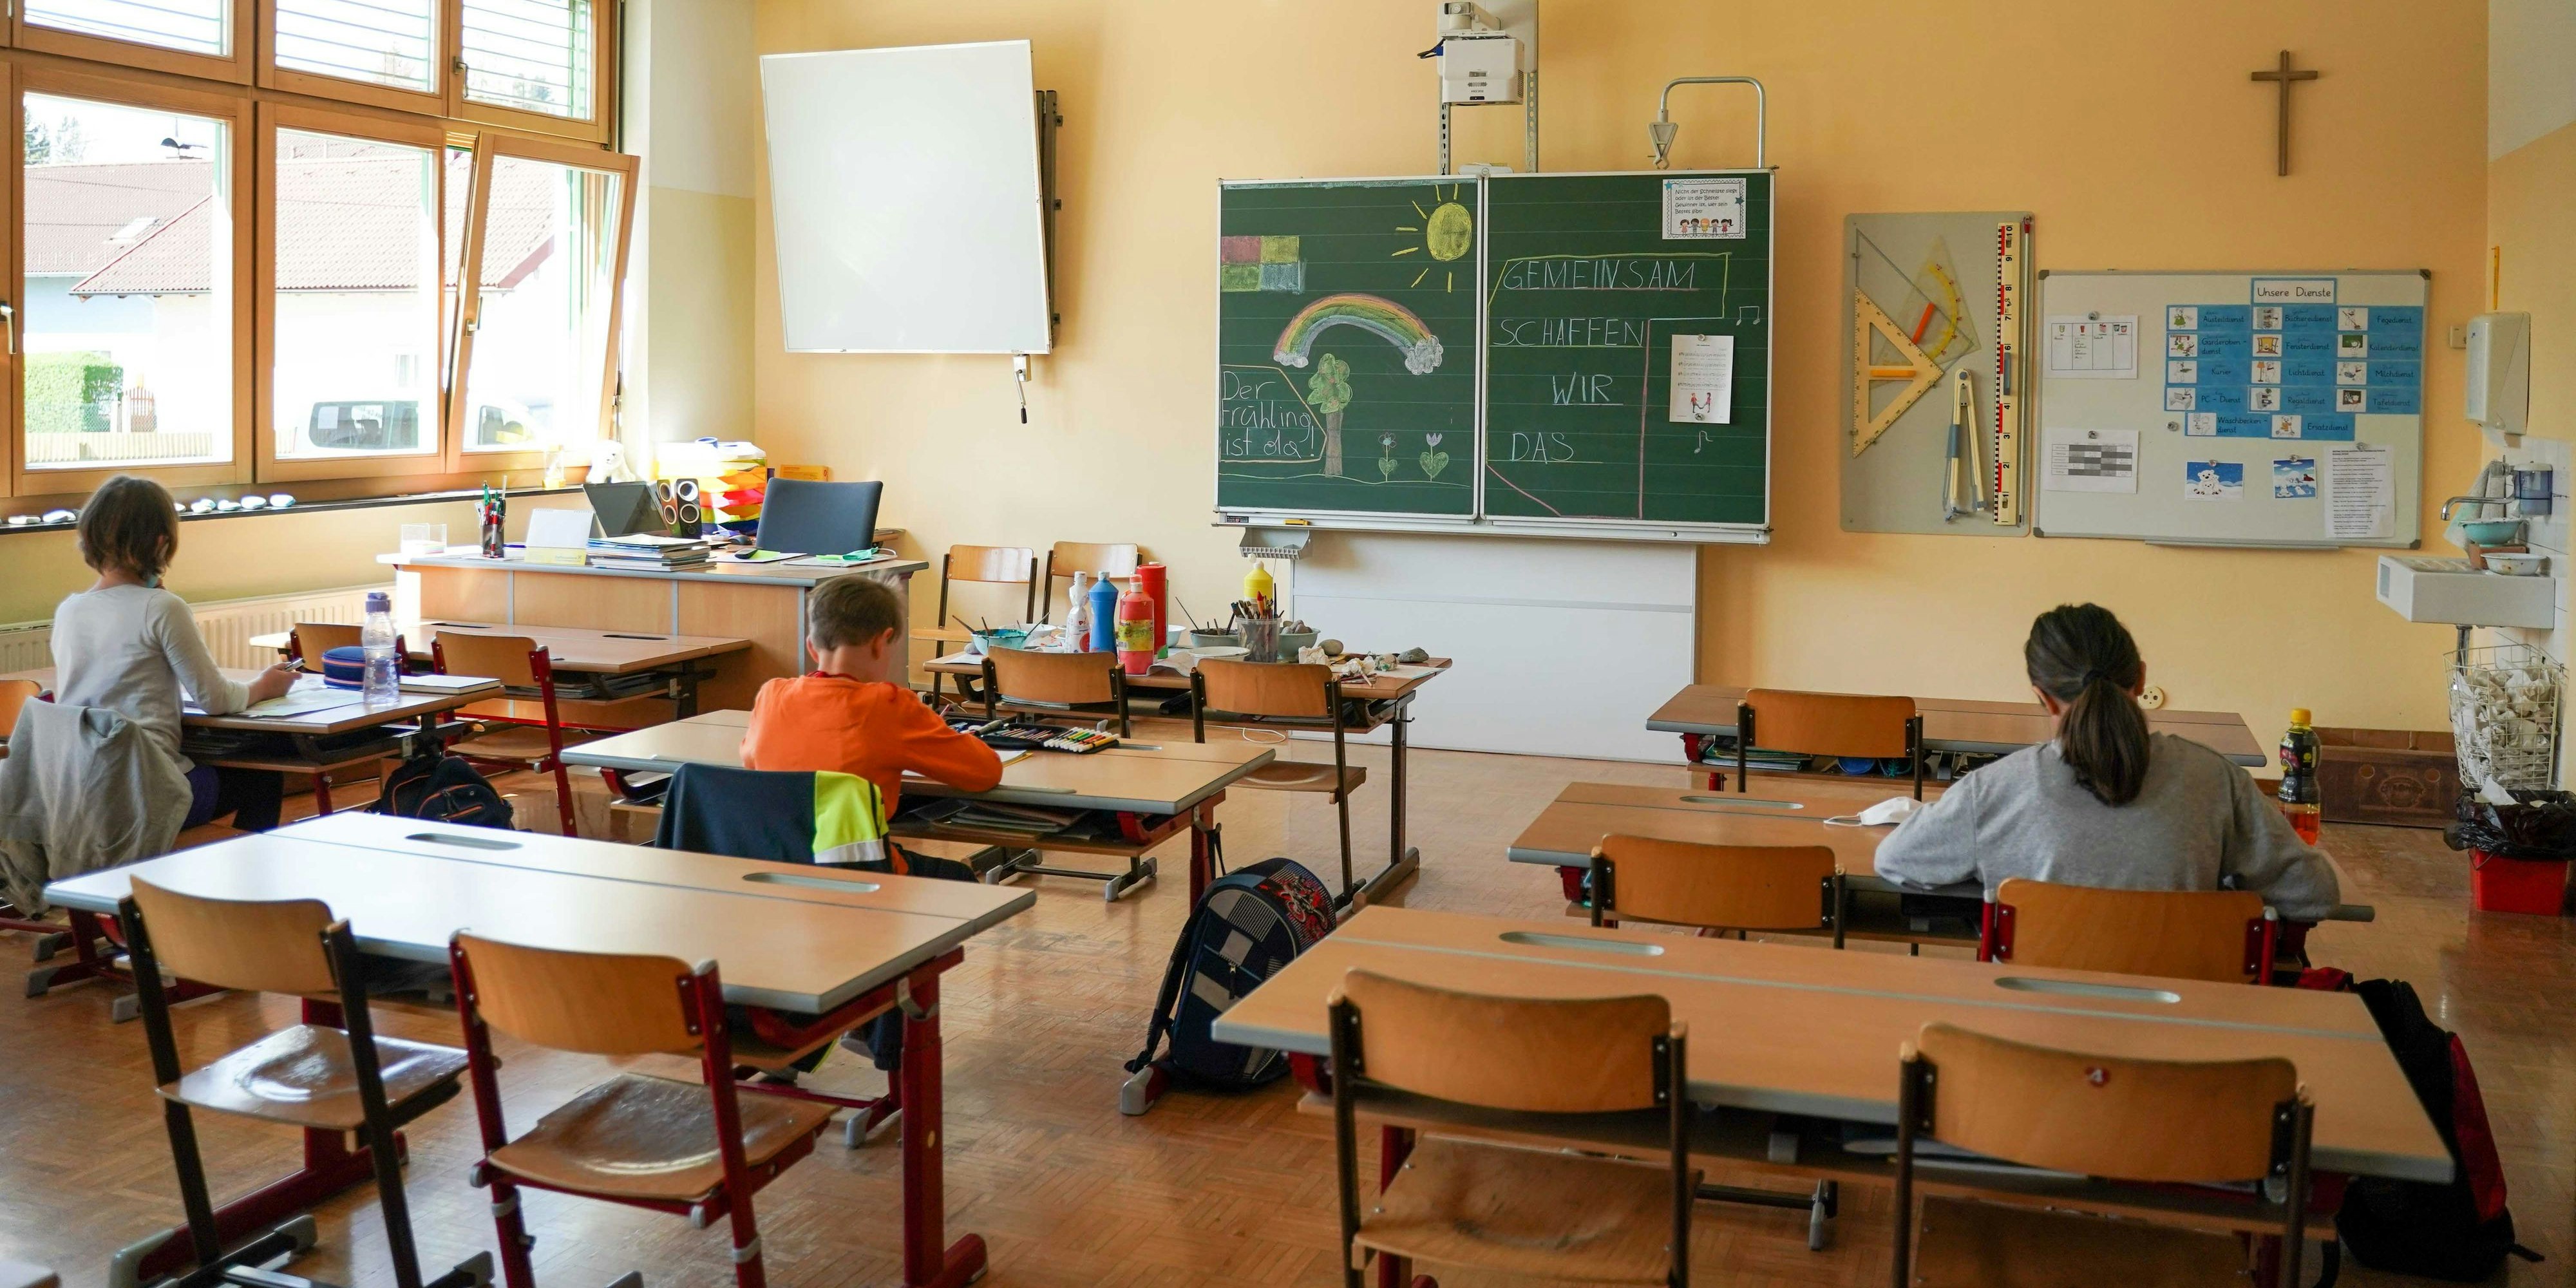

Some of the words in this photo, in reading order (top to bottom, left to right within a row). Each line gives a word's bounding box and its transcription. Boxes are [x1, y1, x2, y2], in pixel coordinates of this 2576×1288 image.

[1503, 260, 1694, 289] GEMEINSAM
[2257, 287, 2289, 297] Unsere
[2296, 287, 2331, 297] Dienste
[1493, 317, 1643, 346] SCHAFFEN
[1224, 371, 1276, 400] Der
[1553, 372, 1613, 405] WIR
[2220, 395, 2240, 403] Dienst
[1226, 428, 1253, 456] ist
[1510, 432, 1574, 464] DAS
